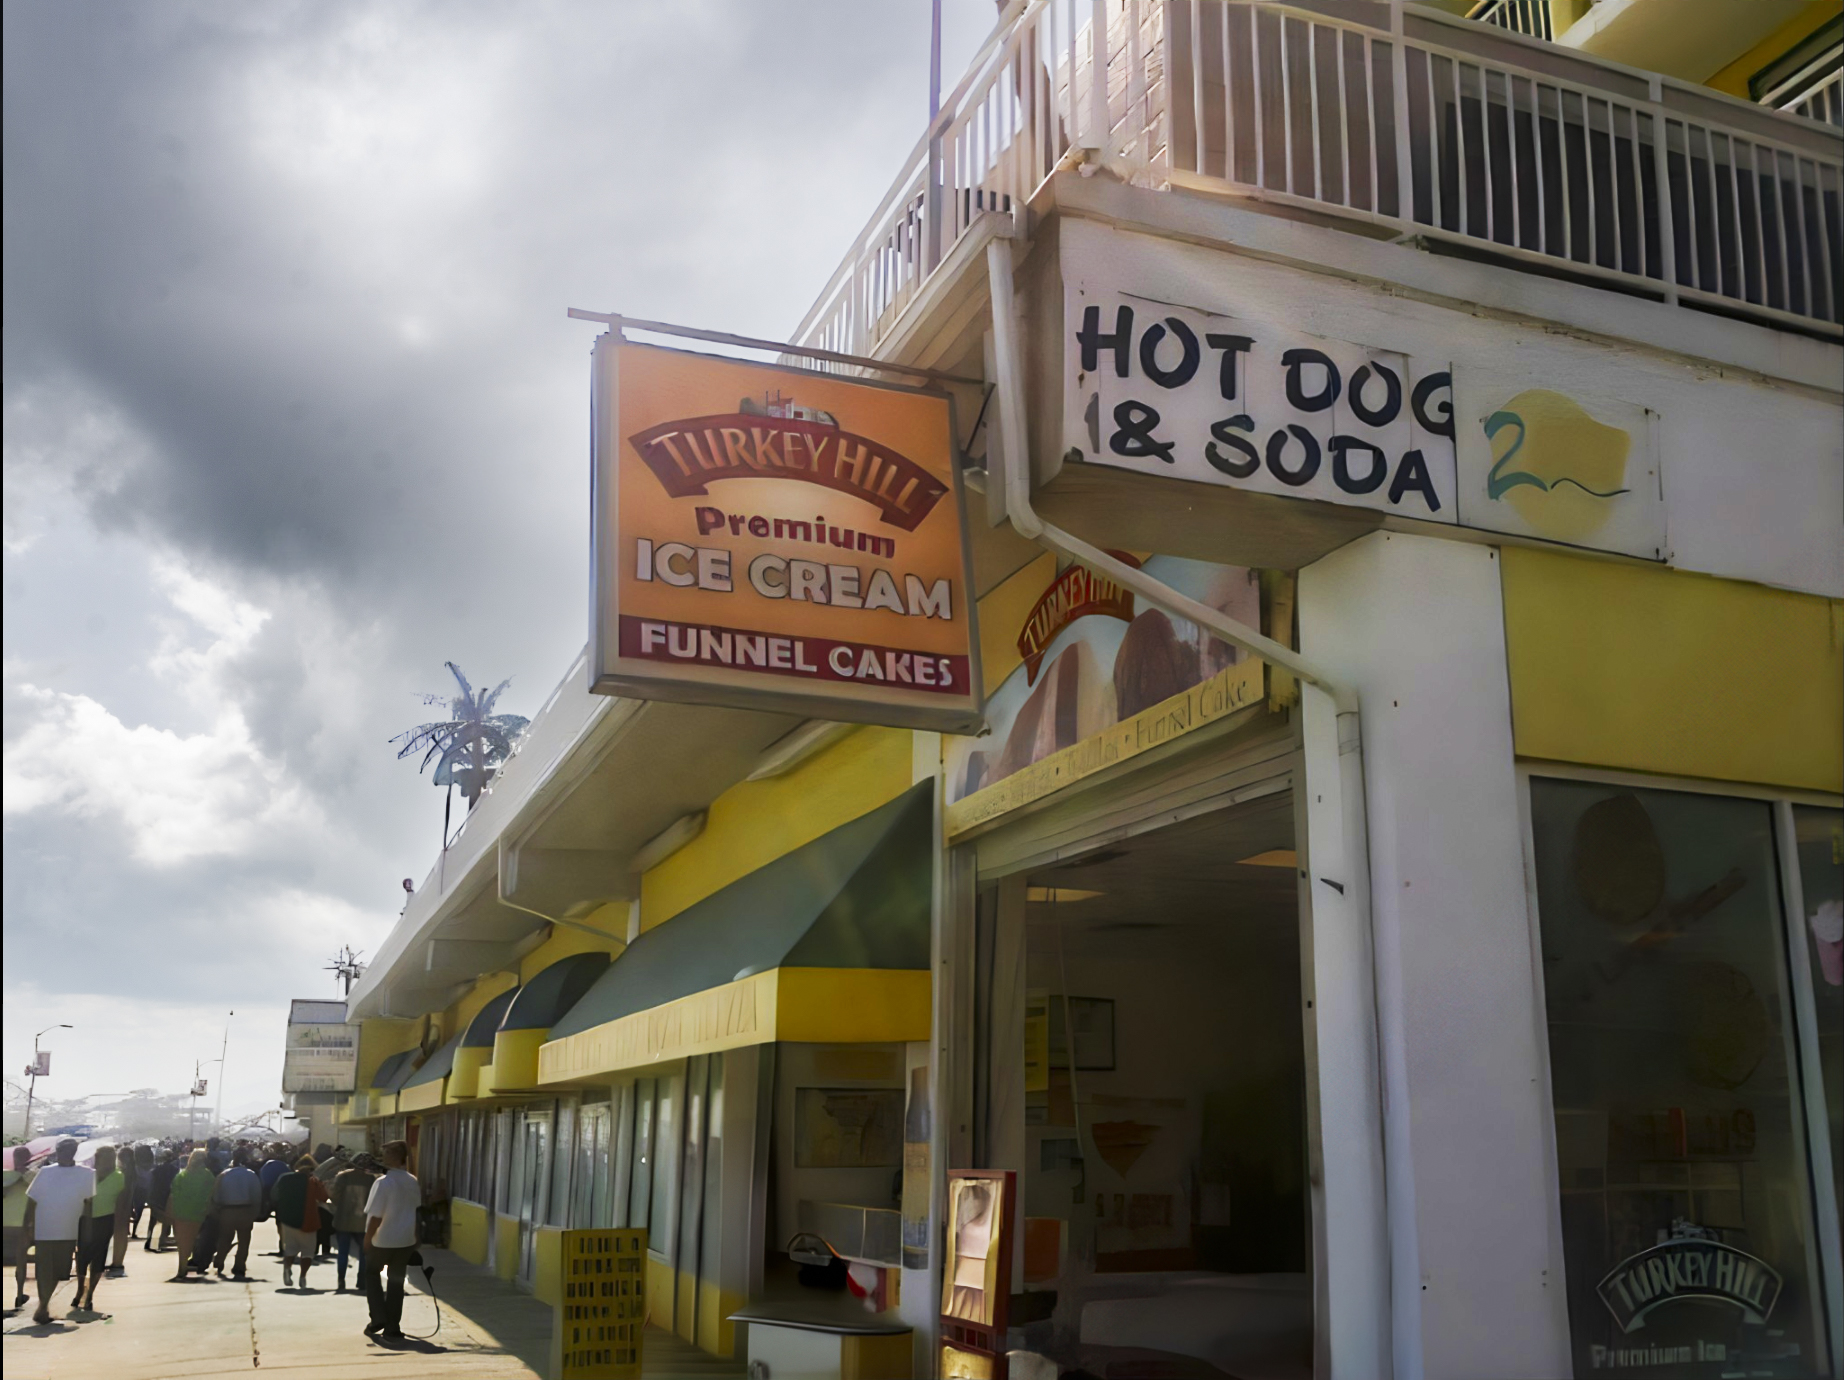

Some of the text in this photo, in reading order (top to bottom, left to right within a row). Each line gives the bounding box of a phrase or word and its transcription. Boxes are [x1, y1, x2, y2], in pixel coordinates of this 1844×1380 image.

[1076, 304, 1455, 442] HOT DOG
[643, 426, 924, 515] TURKEY HILL
[1109, 399, 1442, 513] & SODA
[694, 505, 896, 560] Premium
[635, 537, 953, 621] ICE CREAM
[640, 621, 953, 687] FUNNEL CAKES
